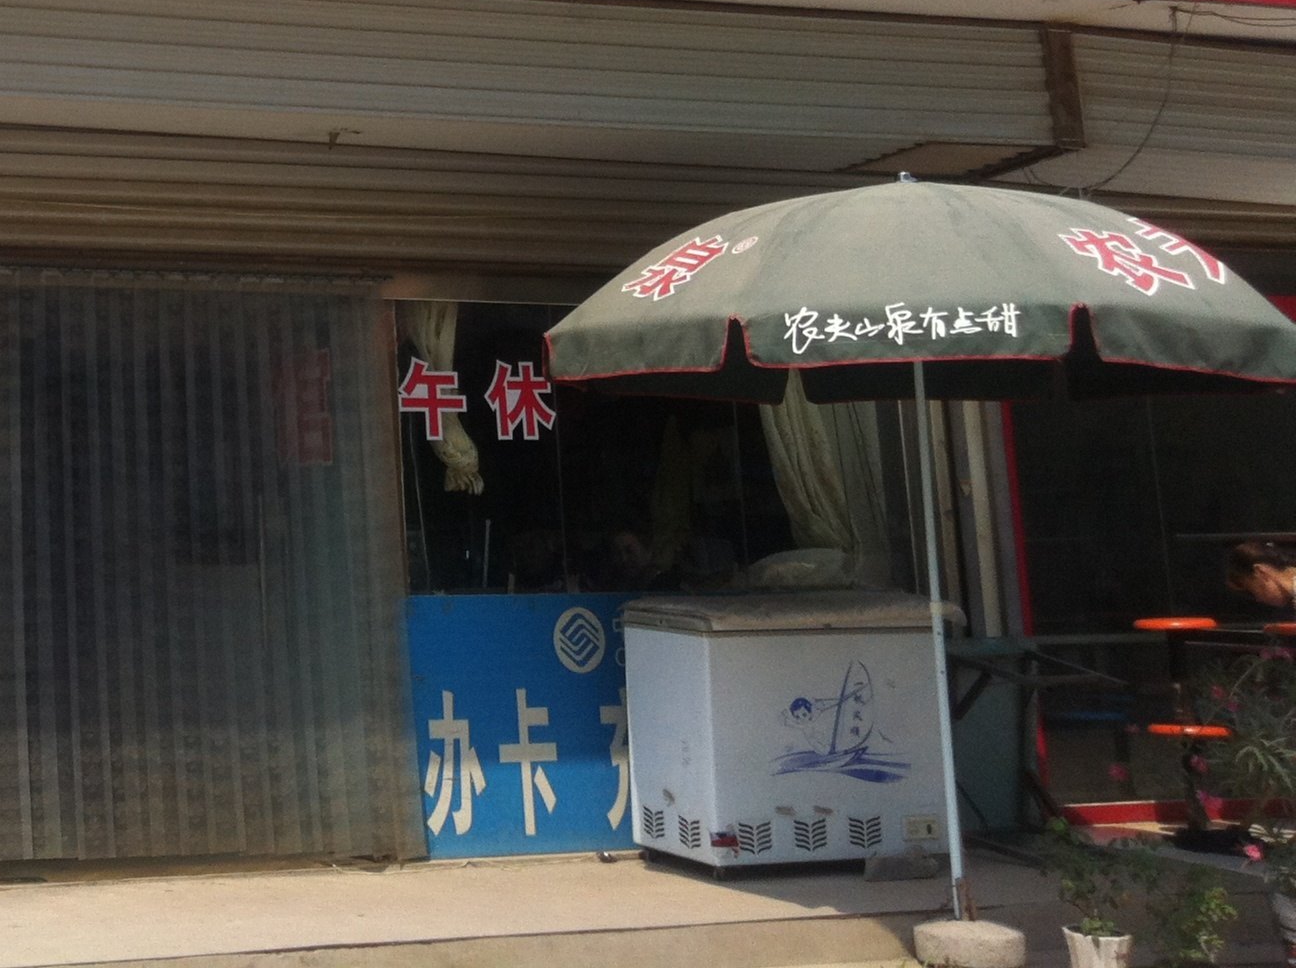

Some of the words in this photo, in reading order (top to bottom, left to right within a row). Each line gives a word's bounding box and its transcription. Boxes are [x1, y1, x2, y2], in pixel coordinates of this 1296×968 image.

[621, 234, 728, 301] 泉
[784, 303, 1021, 355] 农夫山泉有点甜
[398, 356, 557, 441] 午休
